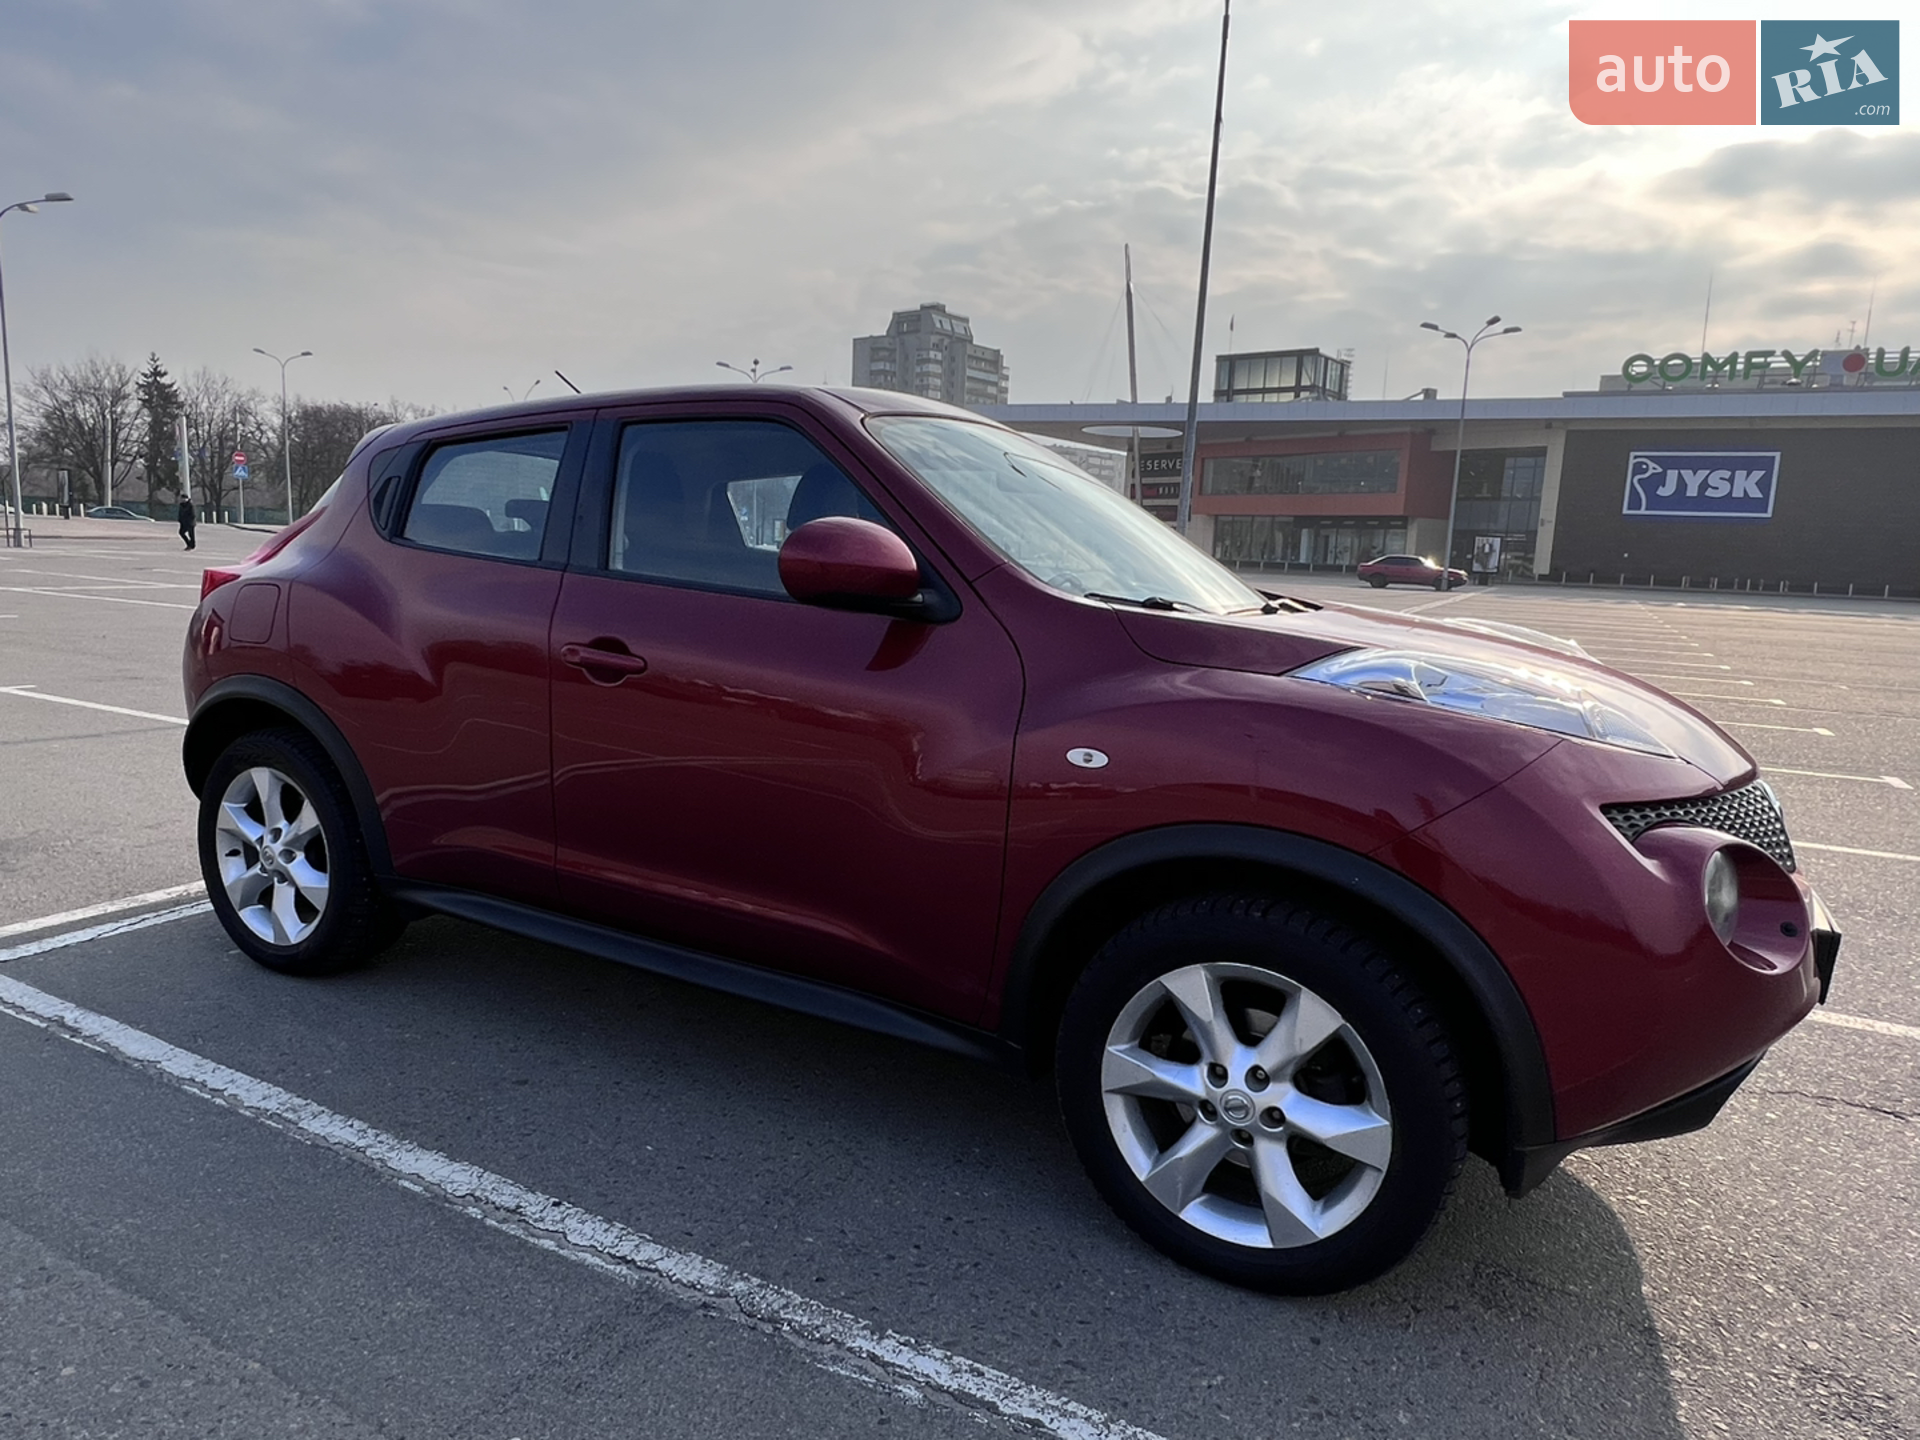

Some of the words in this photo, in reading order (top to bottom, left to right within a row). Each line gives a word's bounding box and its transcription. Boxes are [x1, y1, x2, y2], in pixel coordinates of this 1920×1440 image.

[1621, 349, 1820, 383] COMFY
[1133, 458, 1183, 472] ESERVE
[1656, 469, 1767, 498] JYSK
